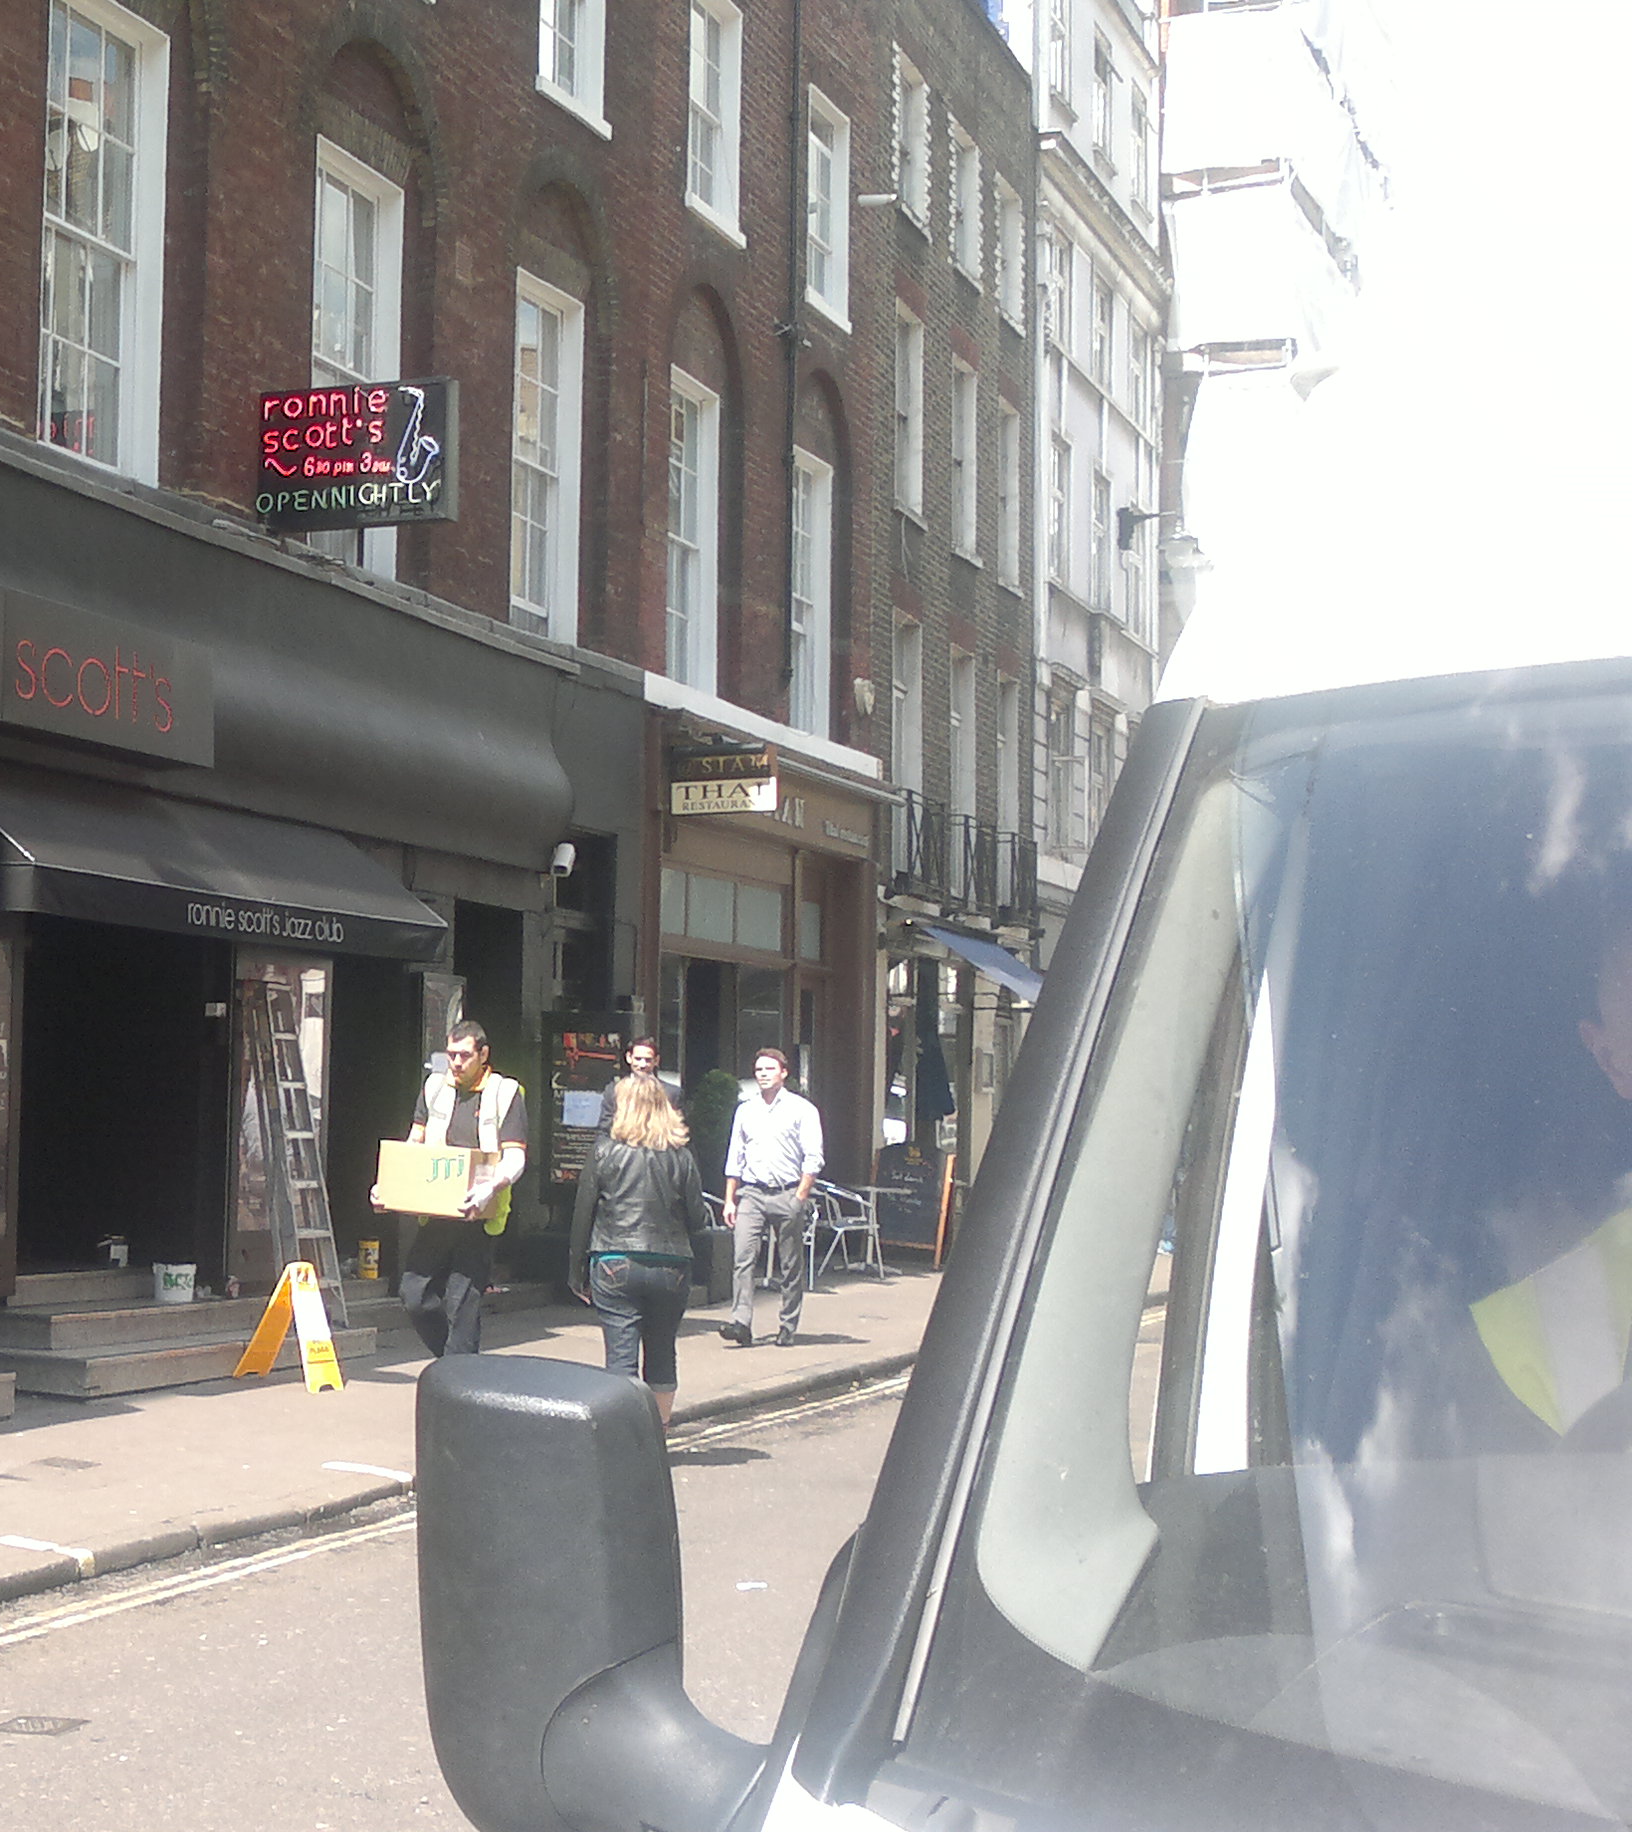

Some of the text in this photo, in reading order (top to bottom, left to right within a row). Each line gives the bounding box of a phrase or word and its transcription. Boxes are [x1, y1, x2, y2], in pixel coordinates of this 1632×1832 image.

[263, 386, 389, 420] ronnie
[262, 417, 384, 453] scott's
[15, 638, 174, 733] scott's
[187, 901, 344, 943] ronnie scott's jazz club
